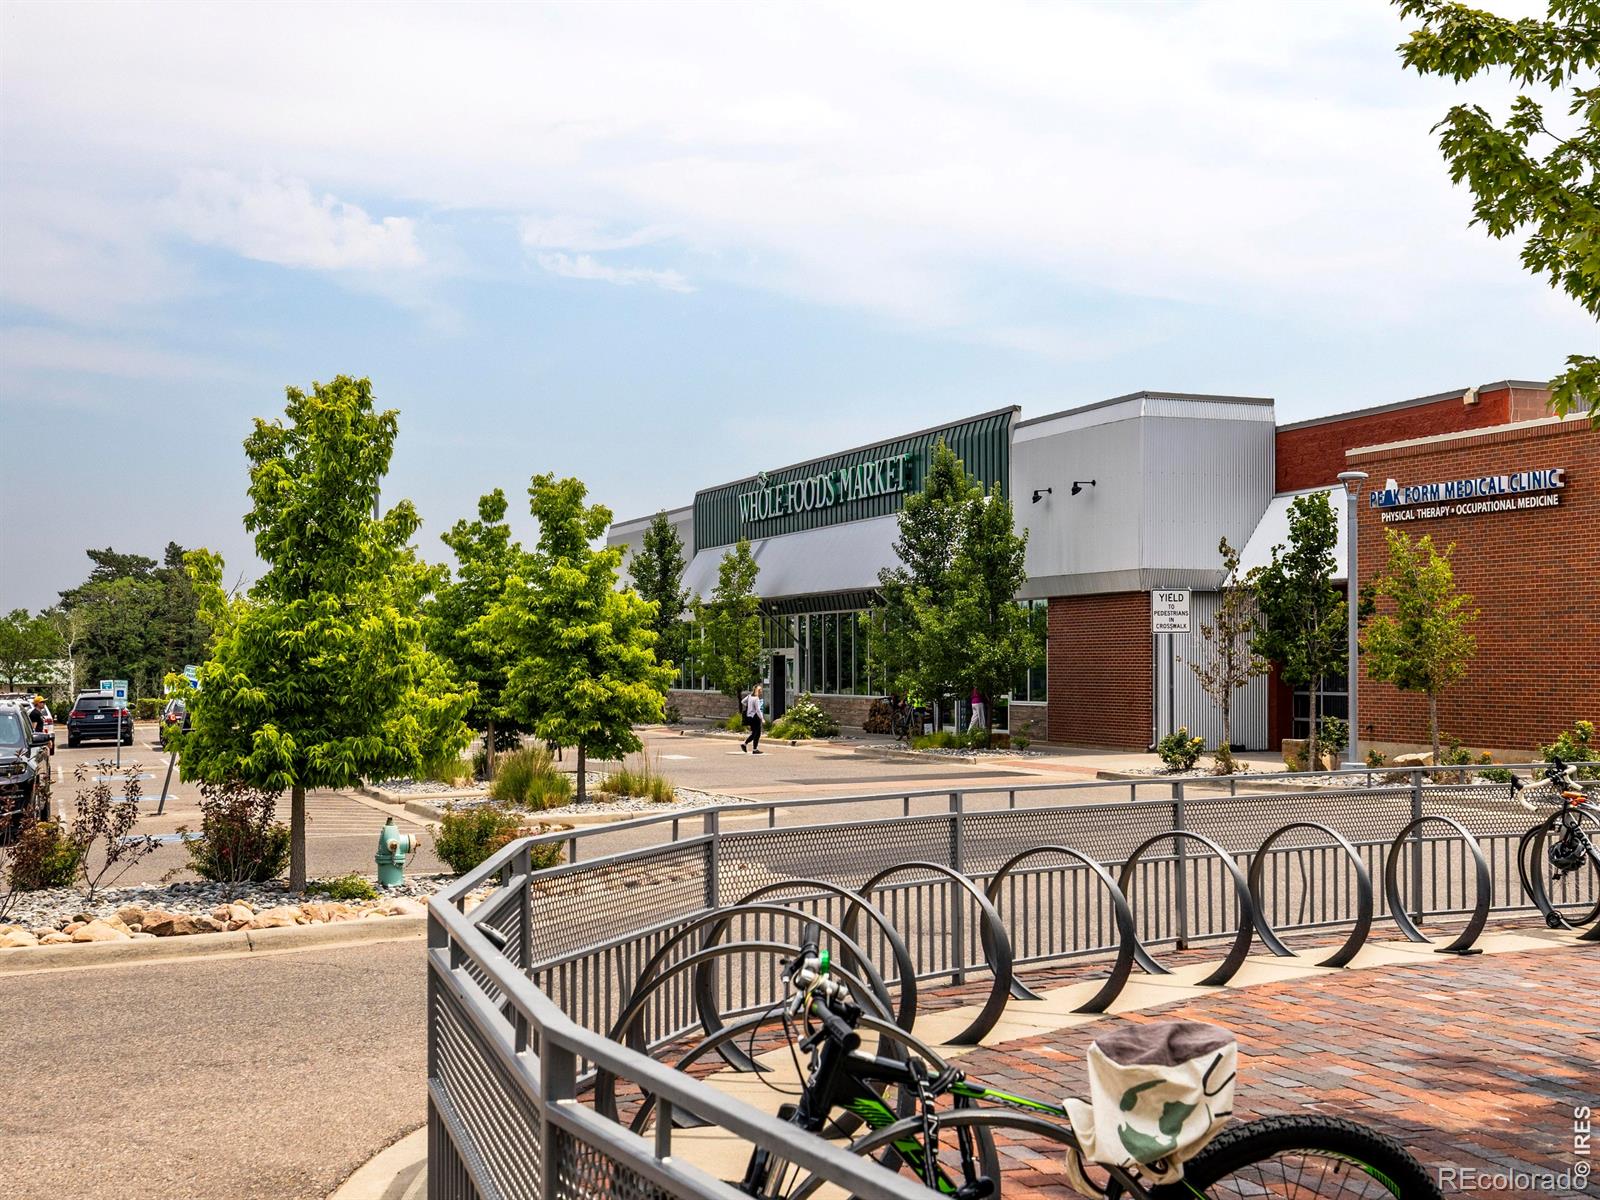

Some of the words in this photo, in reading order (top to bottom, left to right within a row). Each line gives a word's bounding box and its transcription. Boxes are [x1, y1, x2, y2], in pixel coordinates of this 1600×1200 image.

[739, 483, 786, 523] WHOLE
[787, 471, 836, 514] FOODS
[839, 452, 911, 503] MARKET
[1370, 488, 1401, 507] PEAK
[1405, 483, 1440, 504] FORM
[1444, 475, 1506, 500] MEDICAL
[1510, 468, 1561, 494] CLINIC
[1381, 511, 1415, 523] PHYSICAL
[1416, 505, 1451, 519] THERAPY
[1455, 498, 1517, 515] OCCUPATIONAL
[1517, 493, 1559, 509] MEDICINE
[1158, 593, 1184, 602] YIELD
